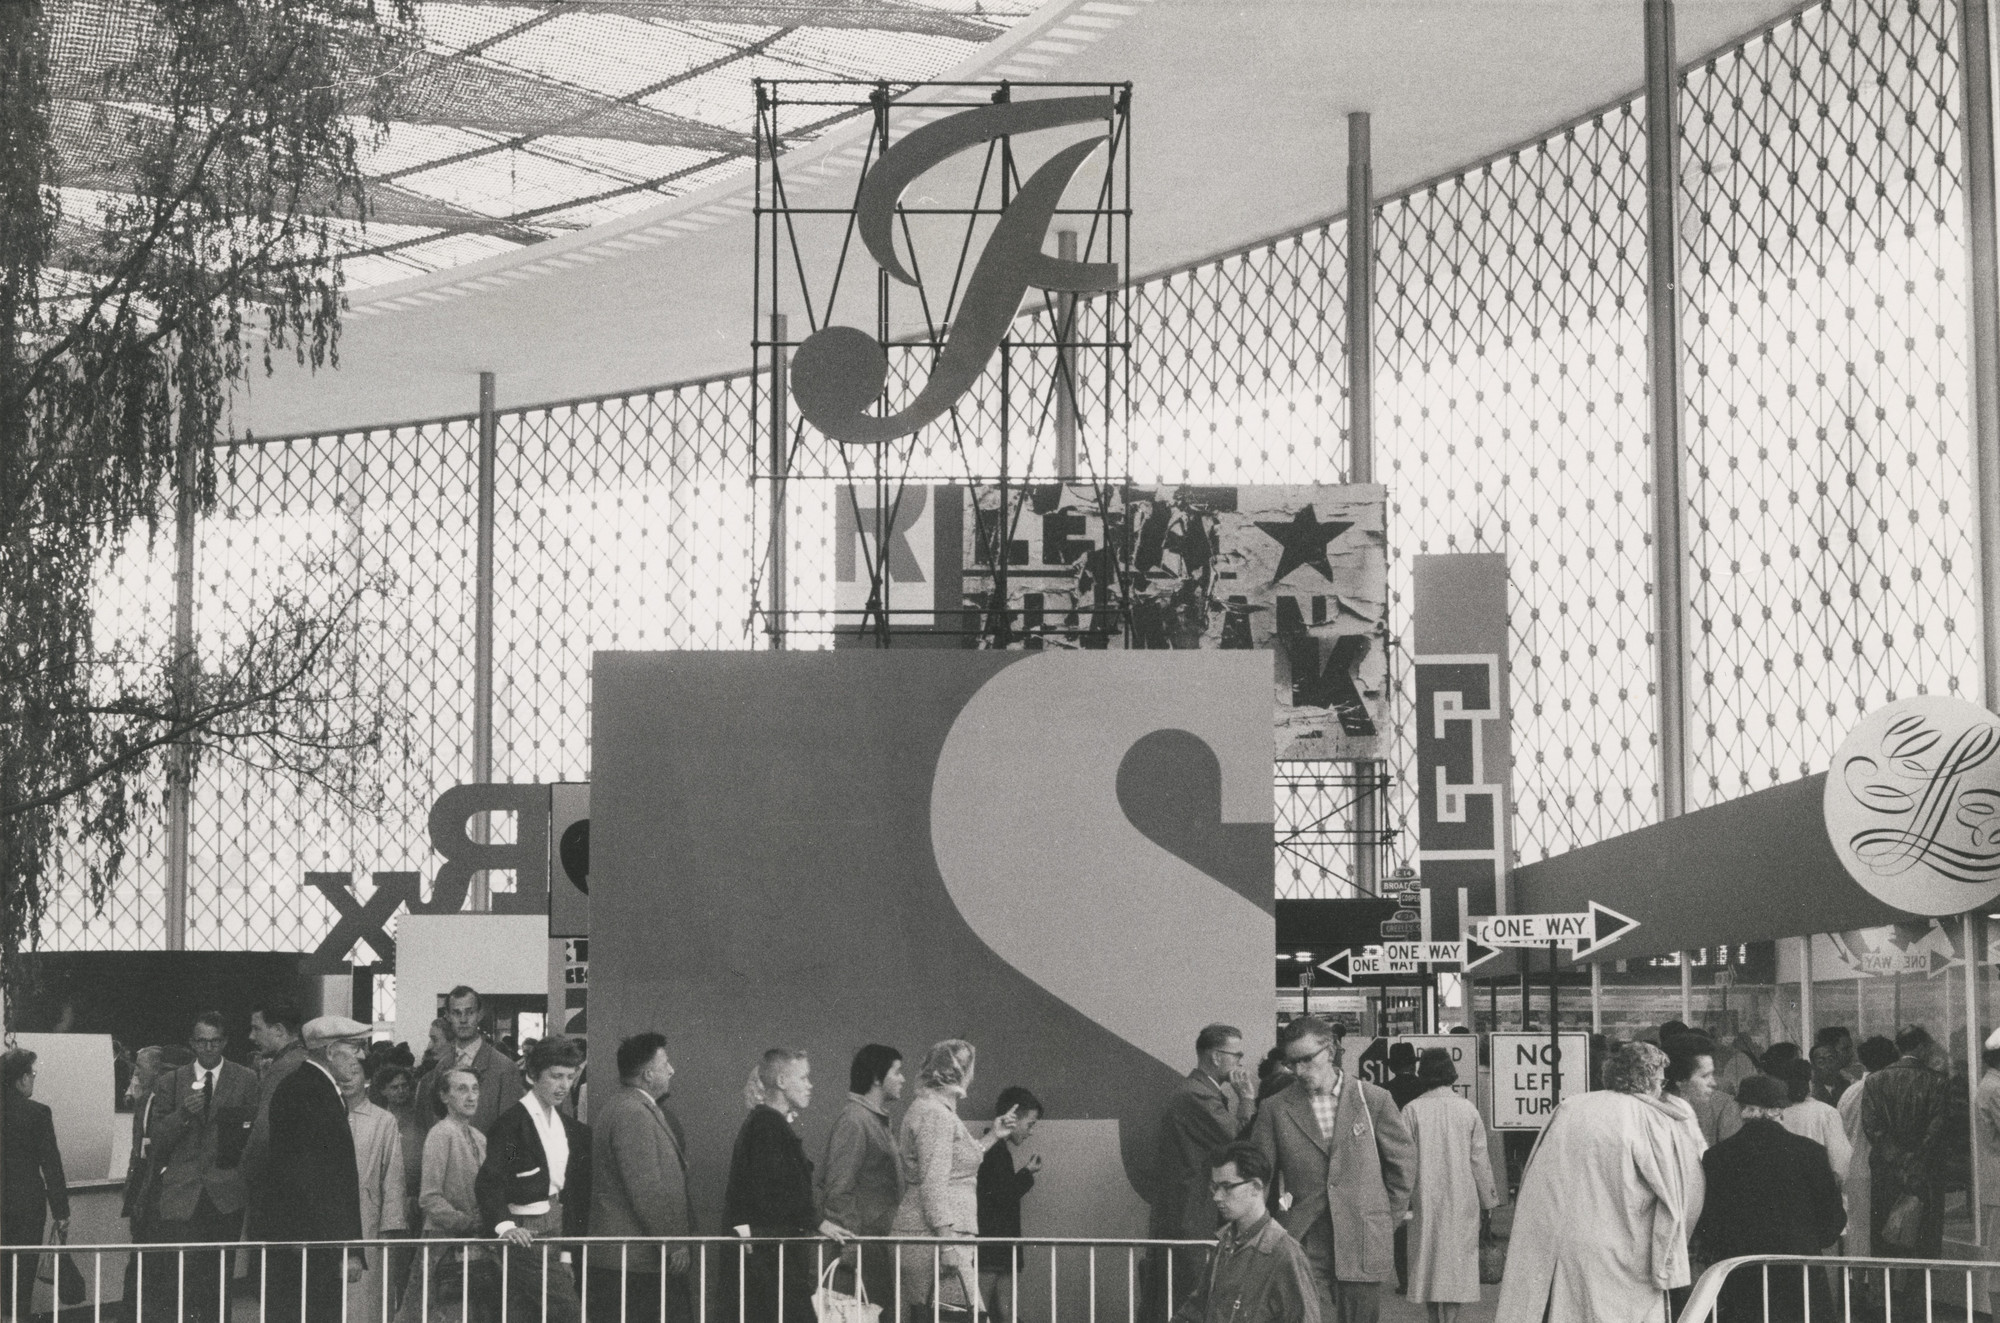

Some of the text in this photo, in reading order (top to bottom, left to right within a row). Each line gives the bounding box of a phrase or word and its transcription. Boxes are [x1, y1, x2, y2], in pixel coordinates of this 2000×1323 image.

[1493, 916, 1586, 938] ONE WAY
[1387, 944, 1461, 960] ONE WAY
[1352, 959, 1414, 972] ONE WAY
[1516, 1043, 1562, 1066] NO
[1362, 1059, 1385, 1084] ST
[1514, 1072, 1565, 1091] LEFT
[1515, 1097, 1564, 1115] TUR
